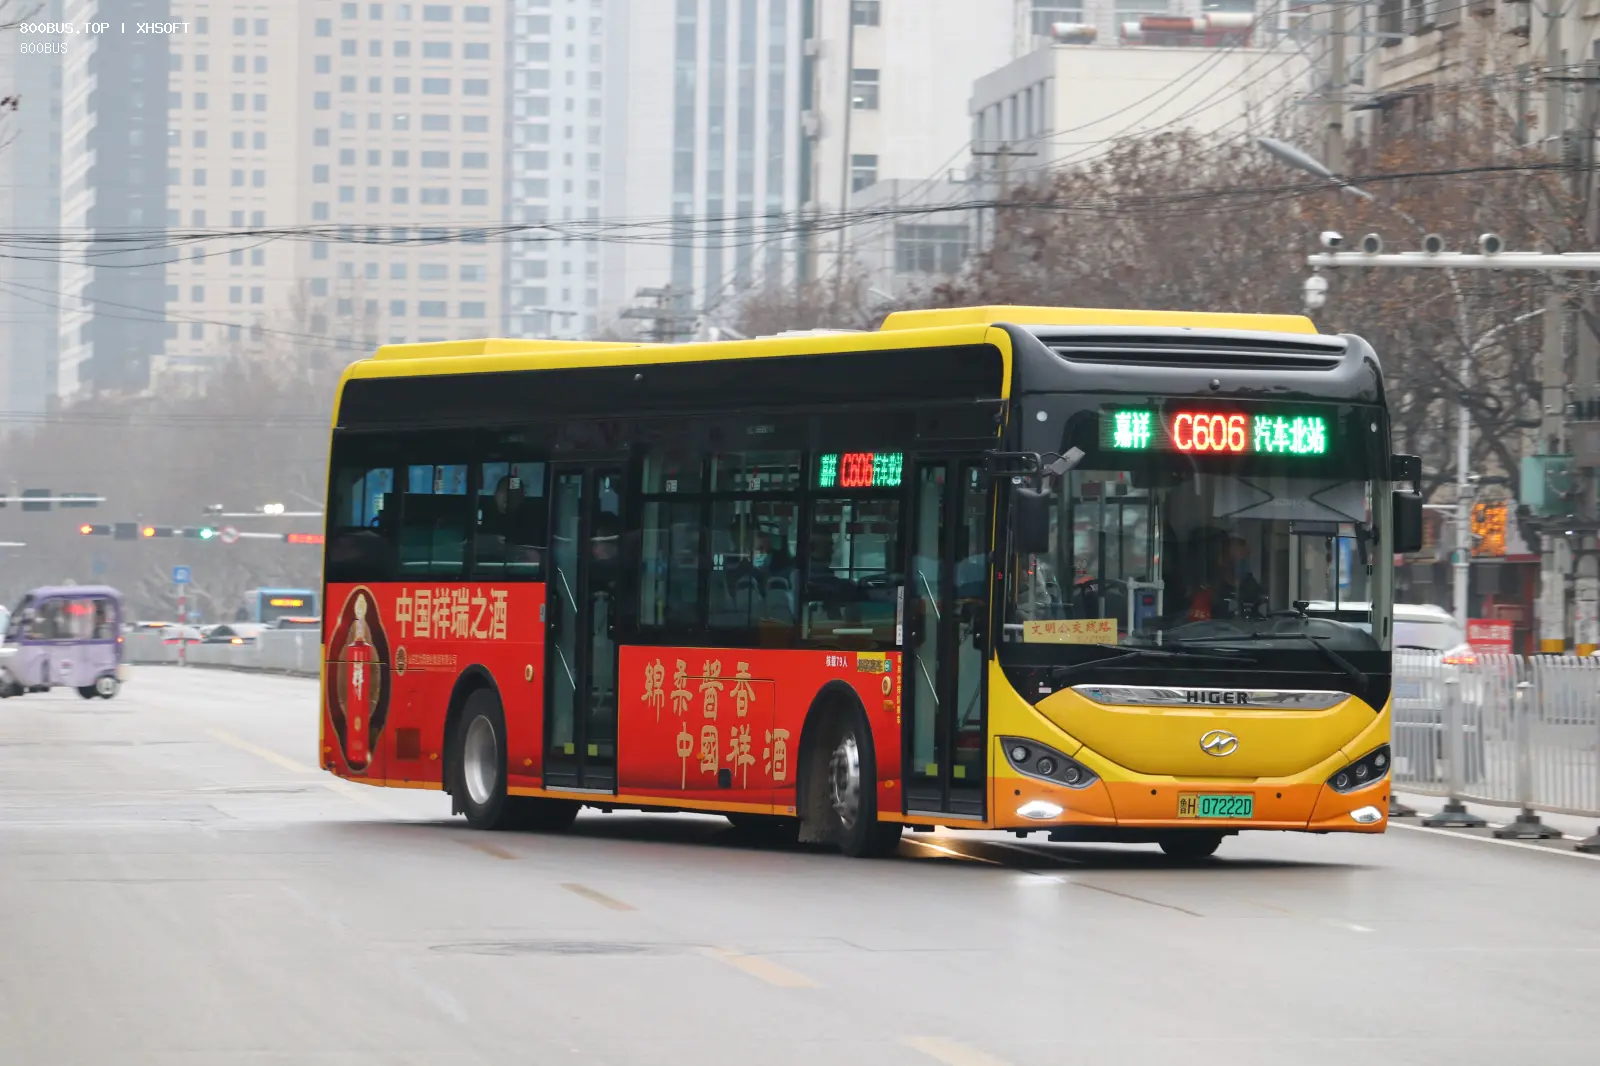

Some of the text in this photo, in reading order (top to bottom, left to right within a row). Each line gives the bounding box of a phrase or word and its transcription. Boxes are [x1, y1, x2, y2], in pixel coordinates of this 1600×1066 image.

[1113, 411, 1325, 453] 嘉祥 C606 汽车北站
[842, 453, 873, 487] C606
[395, 587, 508, 640] 中国祥瑞之酒
[1031, 621, 1112, 635] 文明公交线路
[1186, 690, 1249, 704] HIGER
[1202, 798, 1252, 815] 07222D
